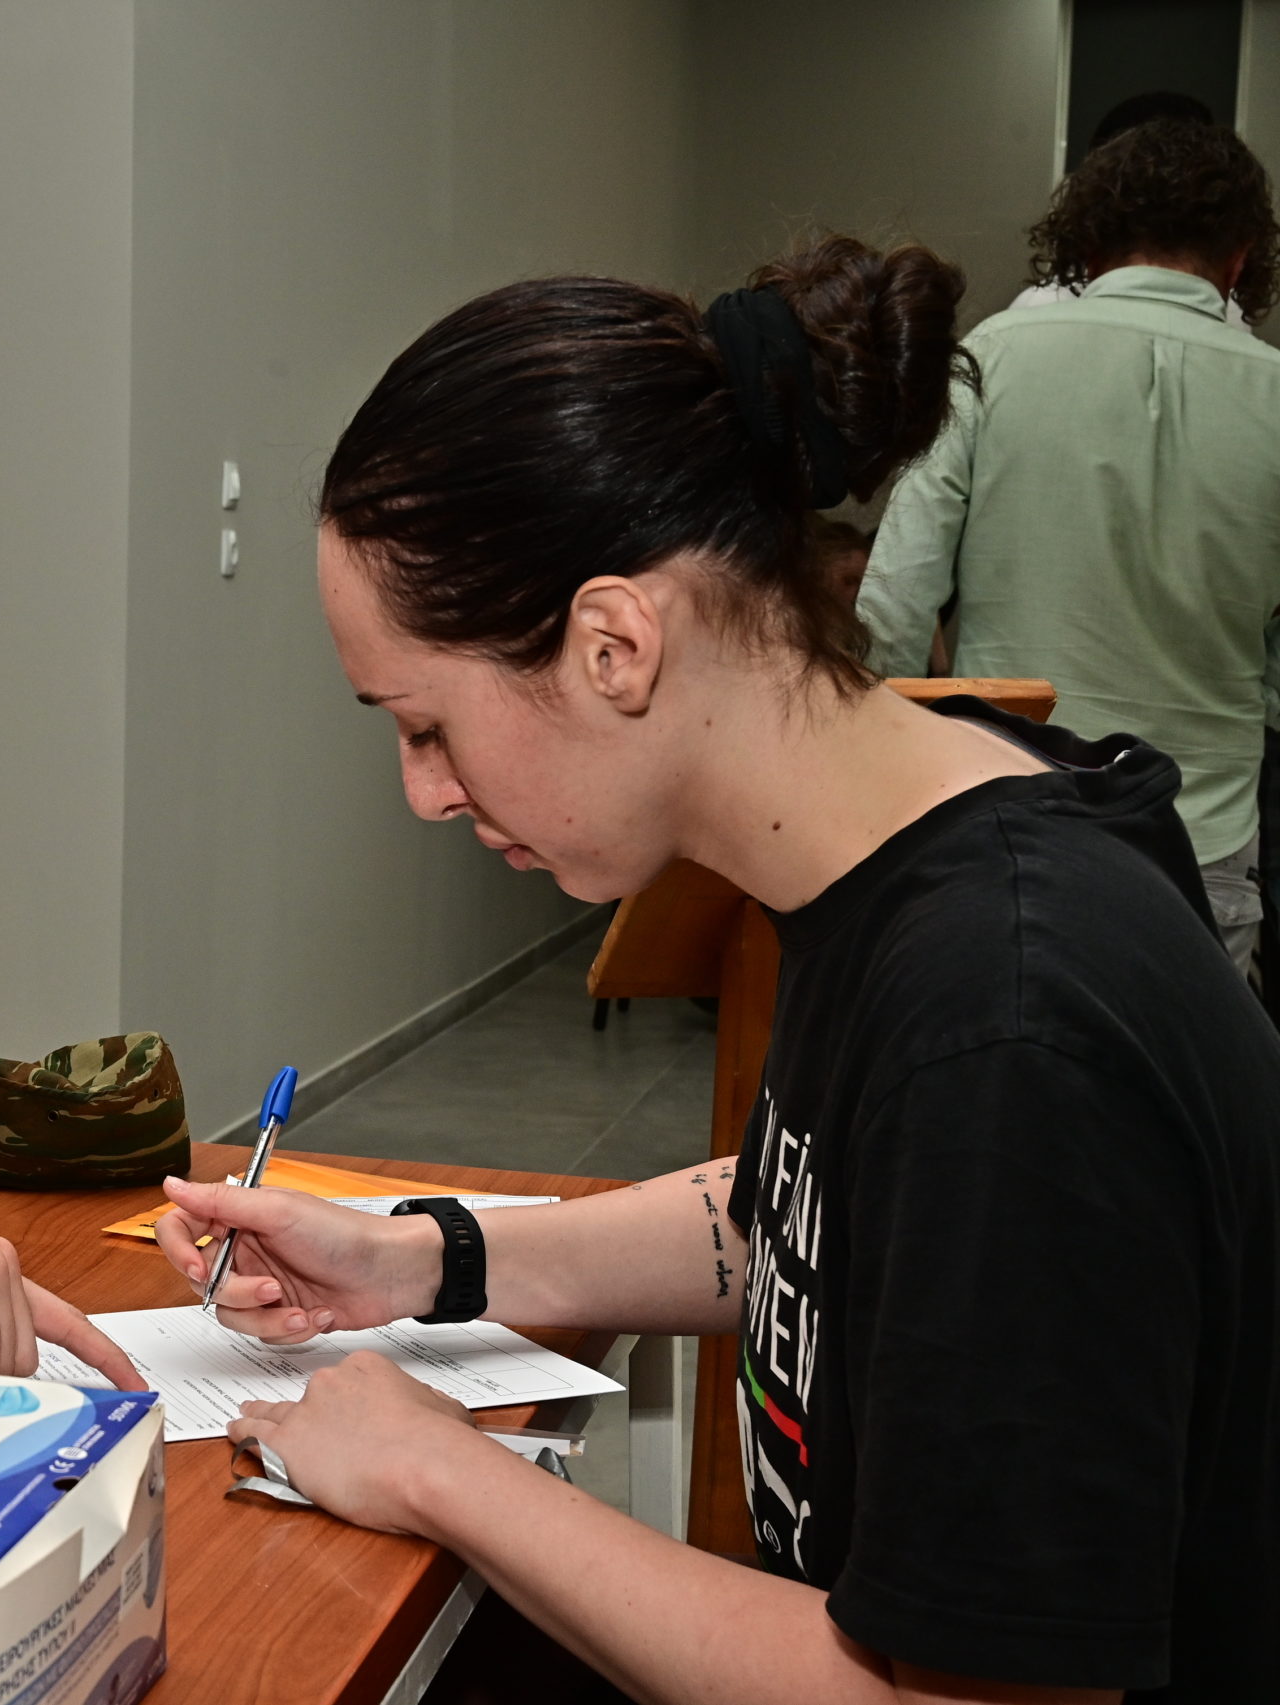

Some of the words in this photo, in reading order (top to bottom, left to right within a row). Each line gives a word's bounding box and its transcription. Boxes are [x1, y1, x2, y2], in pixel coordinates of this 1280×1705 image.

[703, 1191, 719, 1217] not
[712, 1221, 724, 1252] now
[716, 1259, 734, 1299] when
